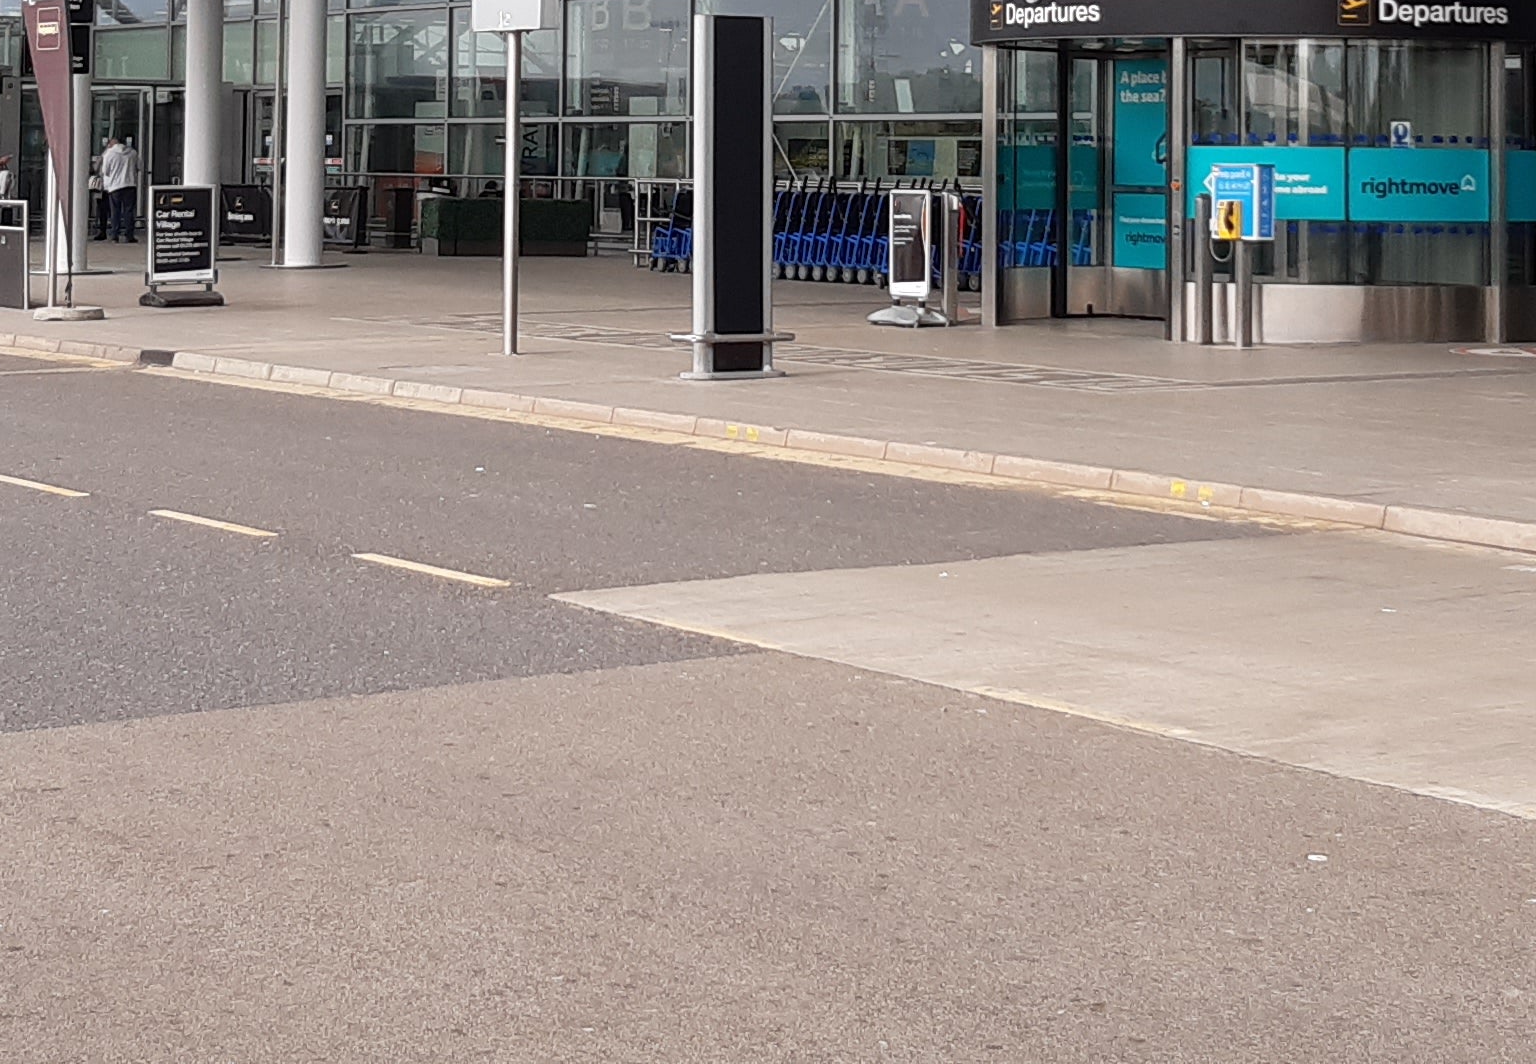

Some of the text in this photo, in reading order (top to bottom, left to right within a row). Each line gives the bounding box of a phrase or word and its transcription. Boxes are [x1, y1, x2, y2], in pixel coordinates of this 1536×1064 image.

[1005, 2, 1101, 28] Departures
[1120, 89, 1139, 103] the
[1361, 177, 1460, 199] rightmove
[156, 210, 170, 218] Car
